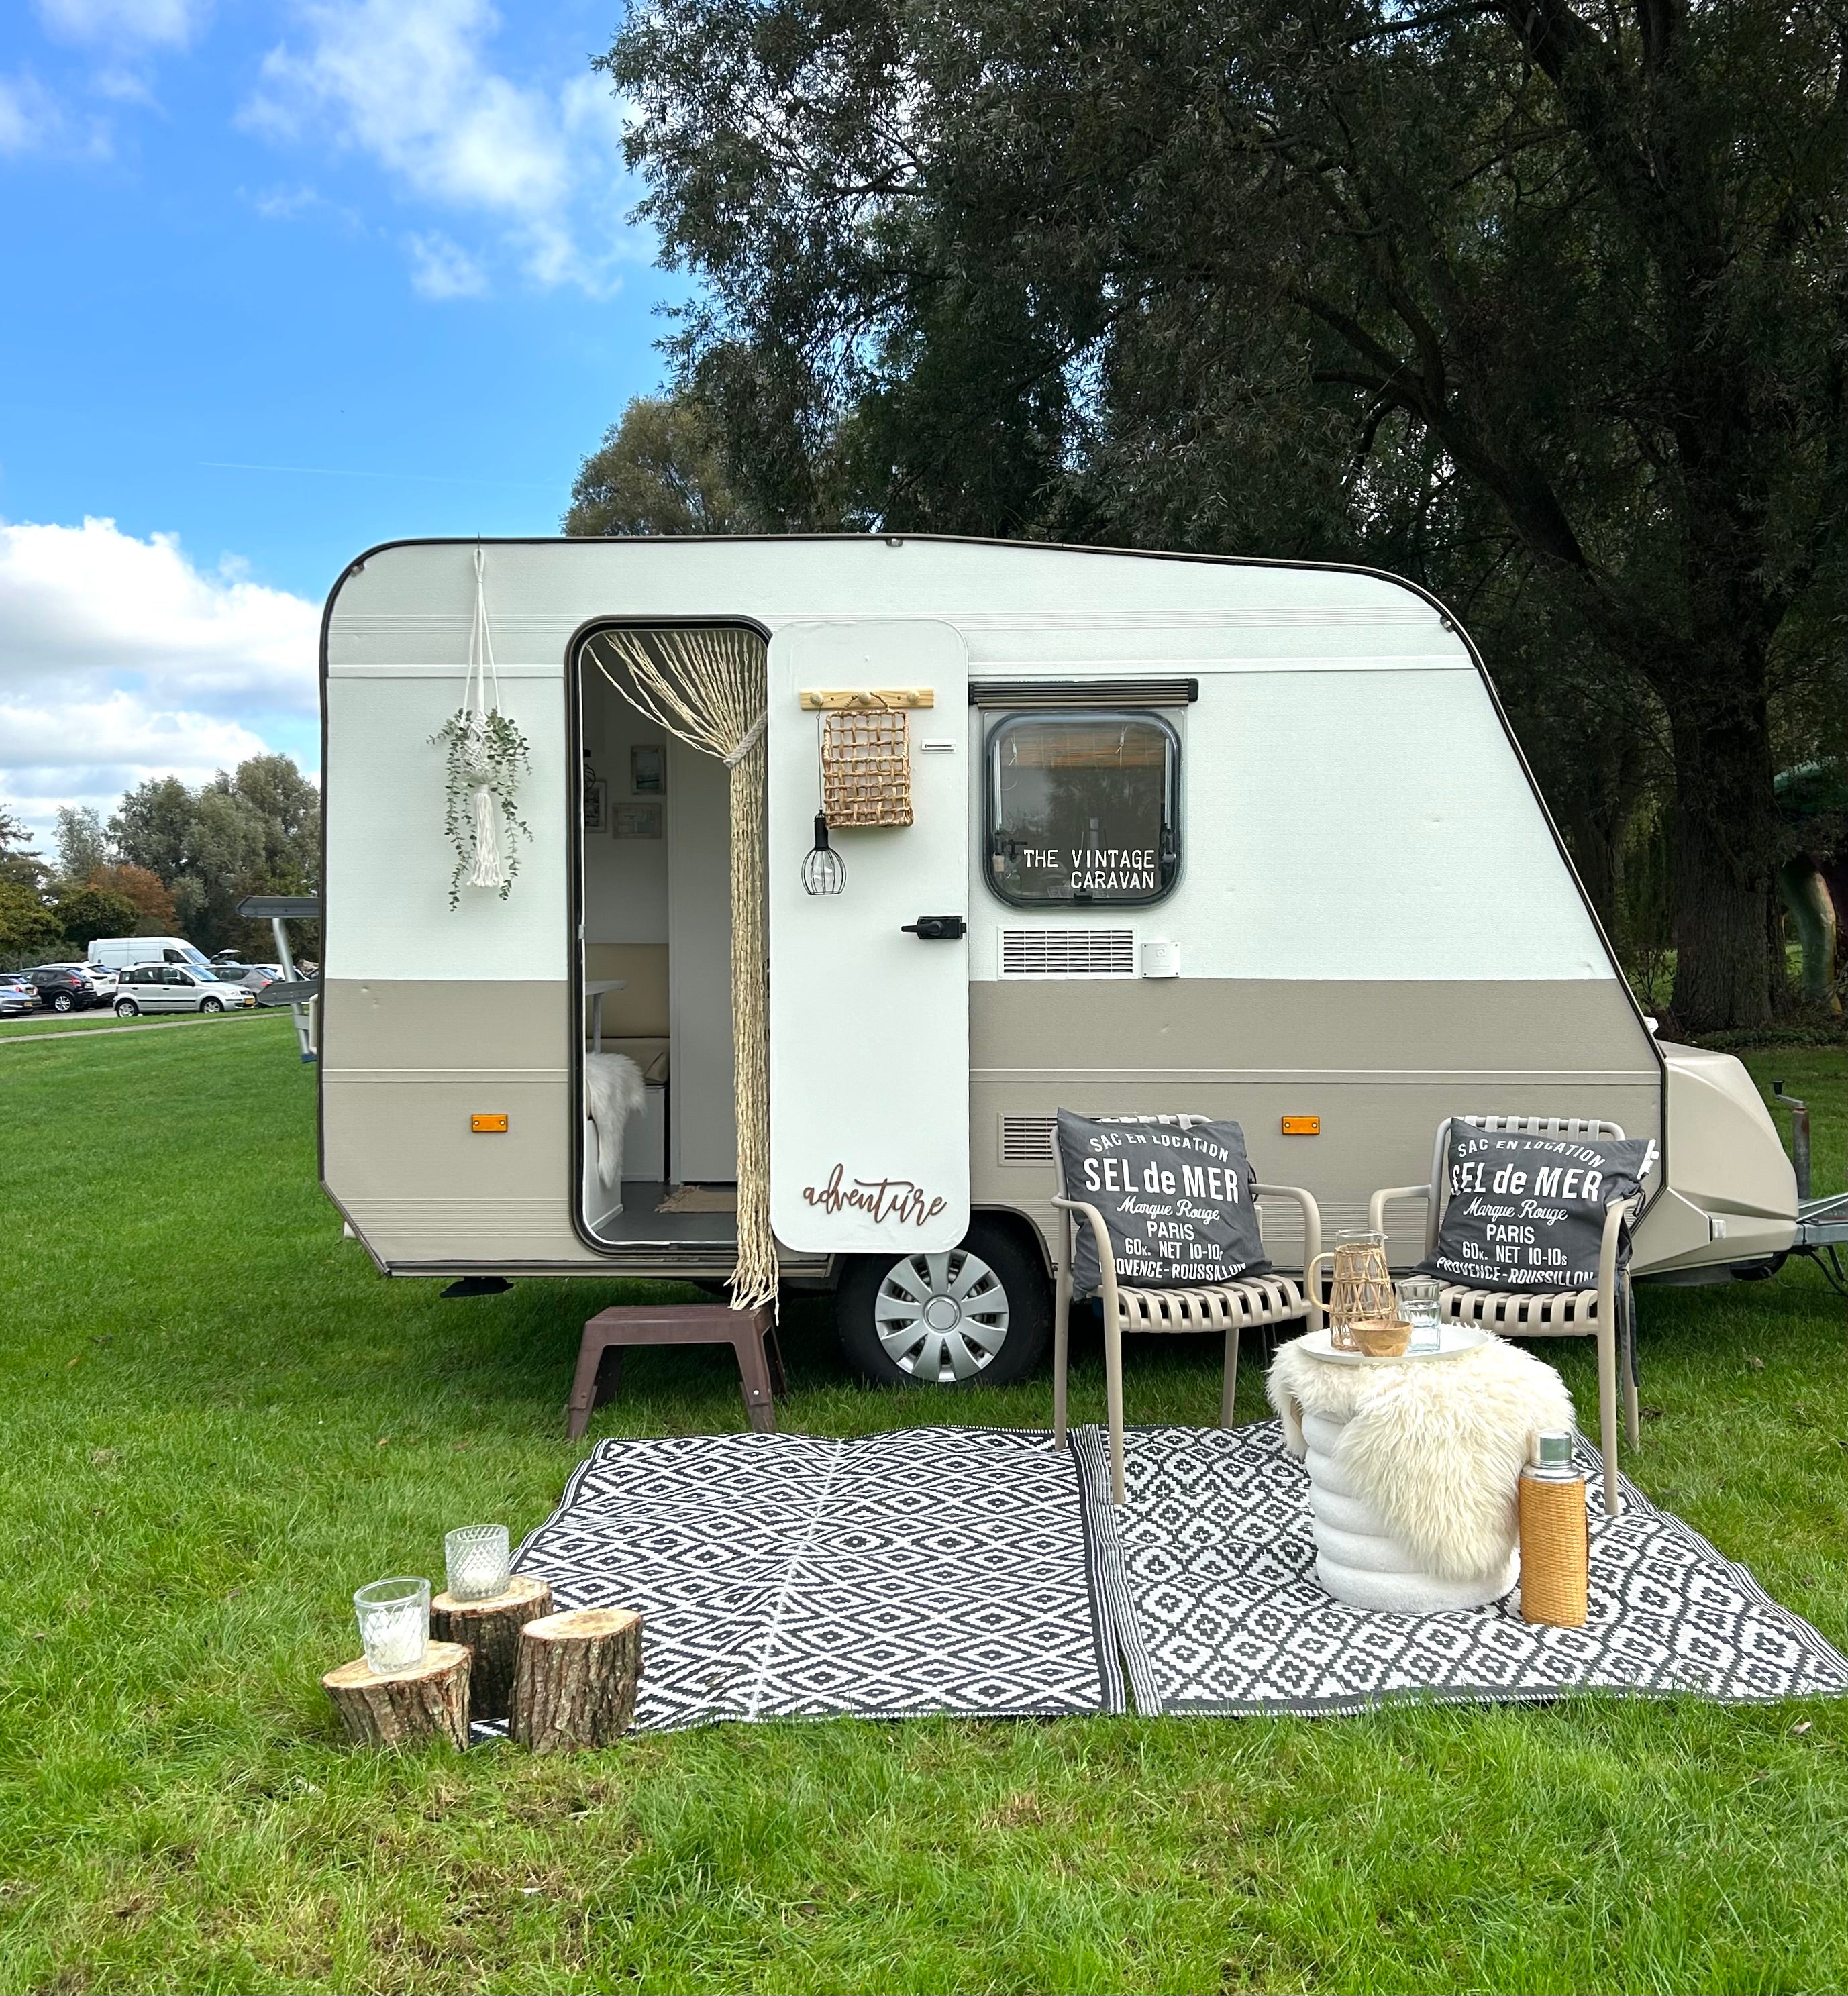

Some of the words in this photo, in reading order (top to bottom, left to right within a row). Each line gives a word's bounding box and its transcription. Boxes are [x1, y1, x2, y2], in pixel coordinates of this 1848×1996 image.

[1023, 849, 1058, 868] THE
[1072, 849, 1155, 870] VINTAGE
[1070, 871, 1154, 890] CARAVAN
[1089, 1133, 1122, 1152] SAC
[1151, 1134, 1229, 1163] LOCATION
[1457, 1139, 1489, 1158] SAC
[1496, 1140, 1518, 1150] EN
[1523, 1141, 1606, 1168] LOCATION
[803, 1163, 947, 1226] adventure
[1083, 1157, 1139, 1192] SEL
[1143, 1161, 1176, 1195] de
[1182, 1164, 1239, 1204] MER
[1450, 1162, 1486, 1196] SEL
[1492, 1163, 1527, 1195] de
[1534, 1166, 1603, 1202] MER
[1117, 1195, 1173, 1218] Marque
[1176, 1198, 1220, 1225] Rouge
[1463, 1196, 1515, 1222] Marque
[1517, 1199, 1568, 1226] Rouge
[1147, 1220, 1195, 1241] PARIS
[1486, 1224, 1535, 1245] PARIS
[1158, 1240, 1182, 1259] NET
[1496, 1245, 1521, 1263] NET
